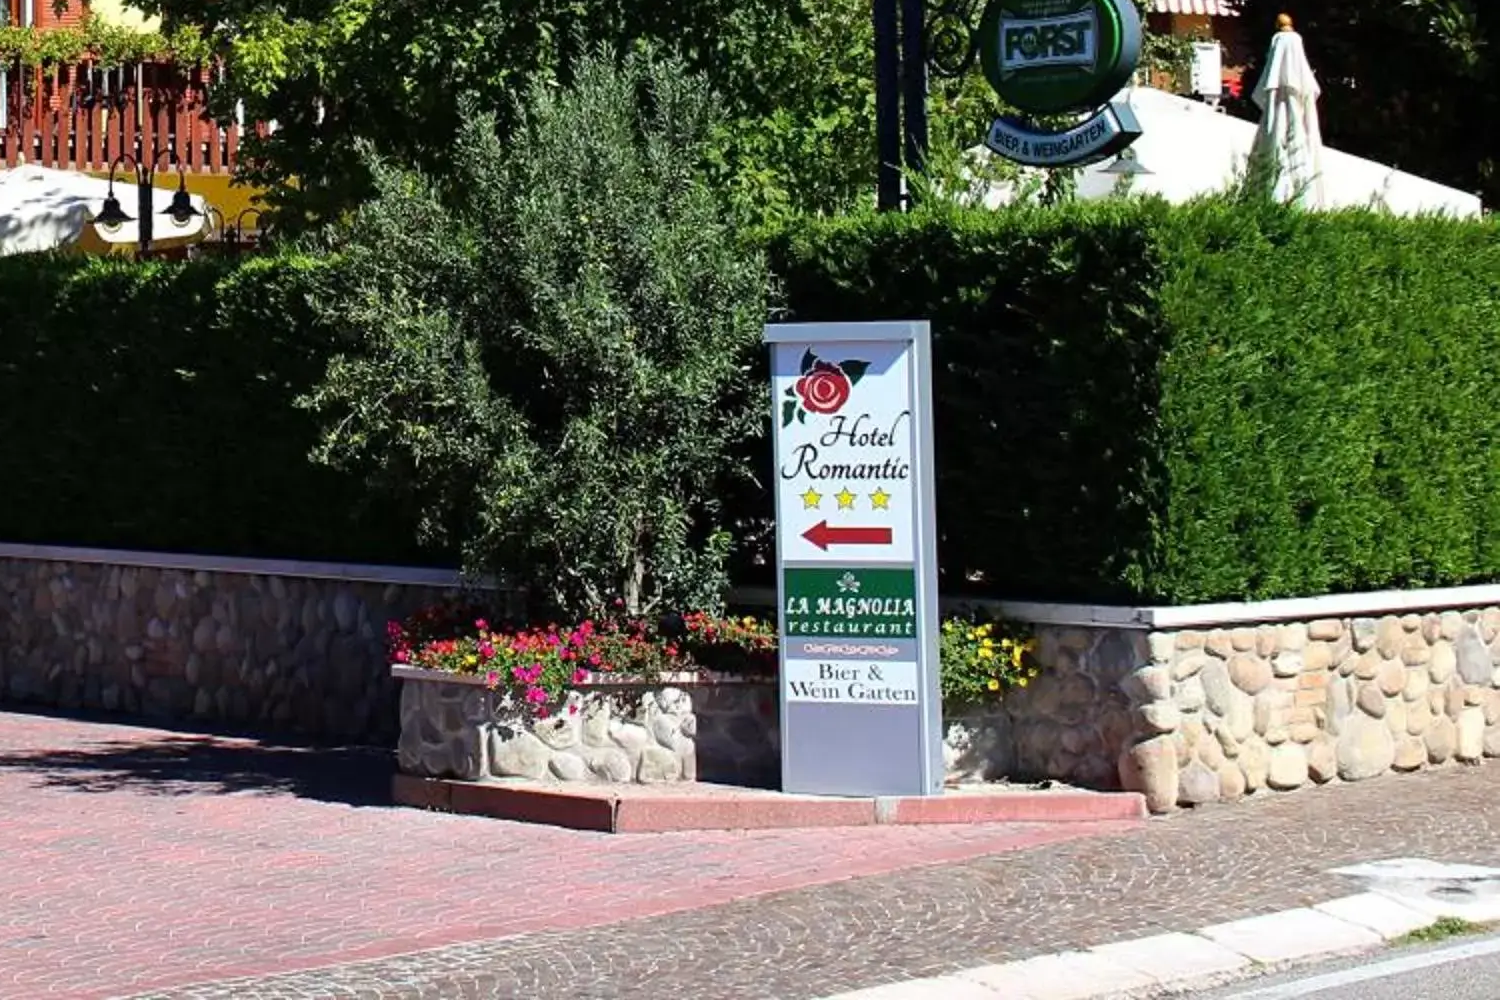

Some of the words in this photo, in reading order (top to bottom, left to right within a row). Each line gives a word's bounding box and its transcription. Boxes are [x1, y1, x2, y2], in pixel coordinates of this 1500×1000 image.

[1006, 20, 1092, 61] FORST
[1031, 119, 1106, 157] WEINGARTEN
[820, 411, 910, 447] Hotel
[781, 443, 909, 480] Romantic
[786, 597, 810, 615] LA
[815, 597, 915, 618] MAGNOLIA
[788, 620, 913, 634] restaurant
[818, 663, 860, 681] Bier
[867, 663, 884, 681] &
[789, 680, 840, 699] Wein
[847, 682, 917, 701] Garten
